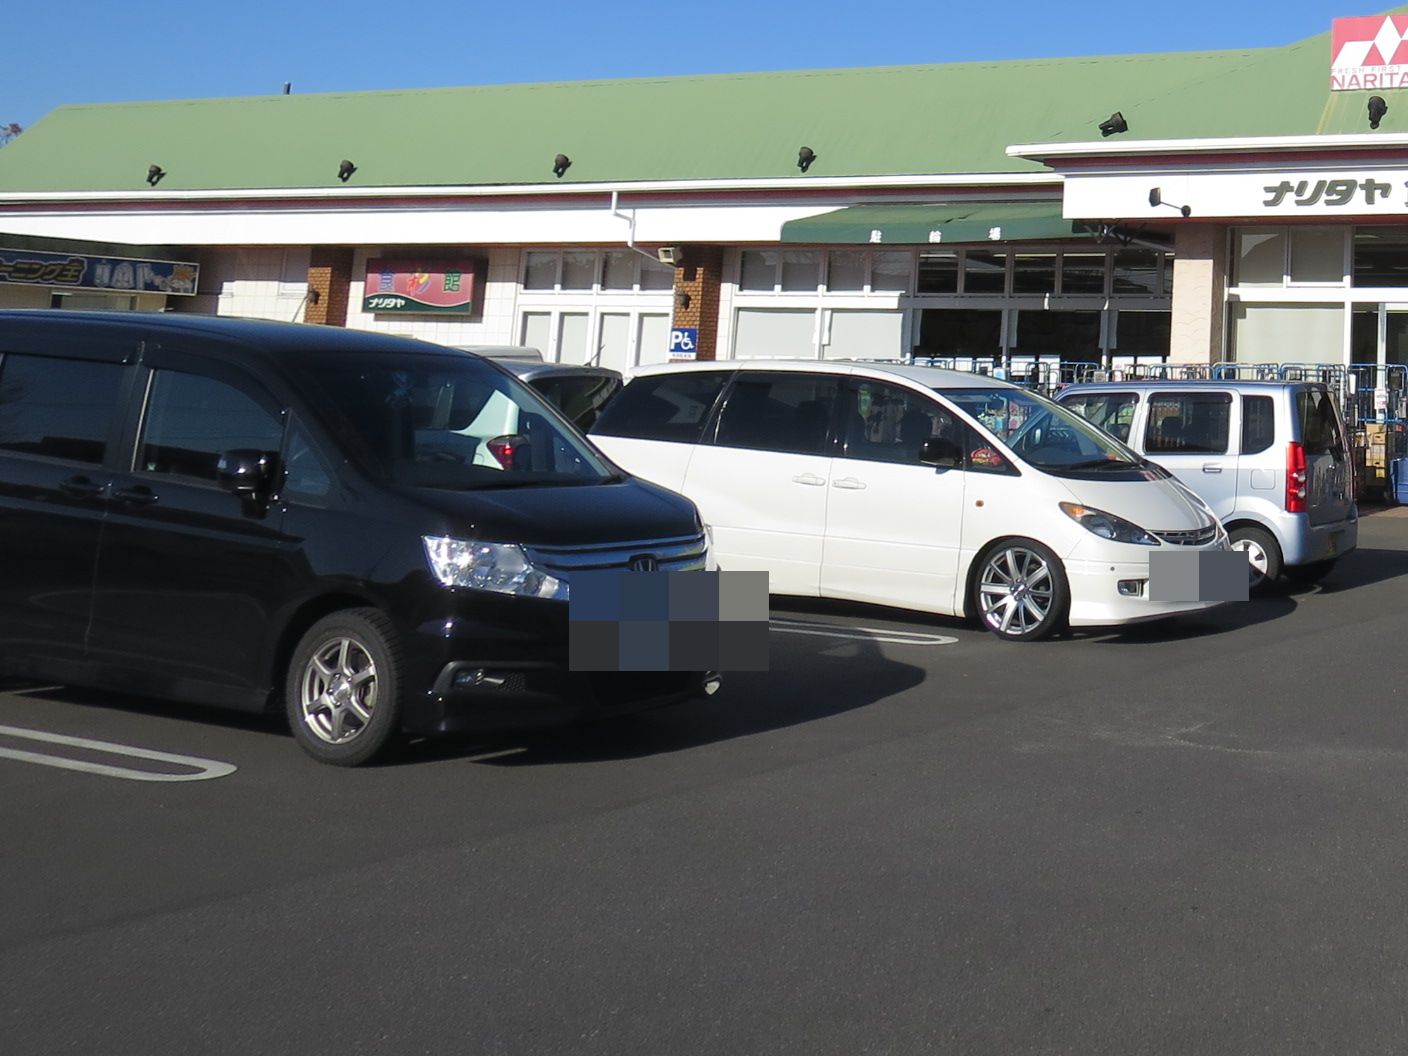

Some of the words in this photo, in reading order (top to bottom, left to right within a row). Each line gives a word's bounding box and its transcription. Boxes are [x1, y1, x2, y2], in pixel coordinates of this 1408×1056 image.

[1371, 64, 1401, 73] FIRST
[1263, 178, 1392, 207] ナリタヤ
[368, 298, 406, 309] ナリタヤ
[670, 331, 683, 350] P
